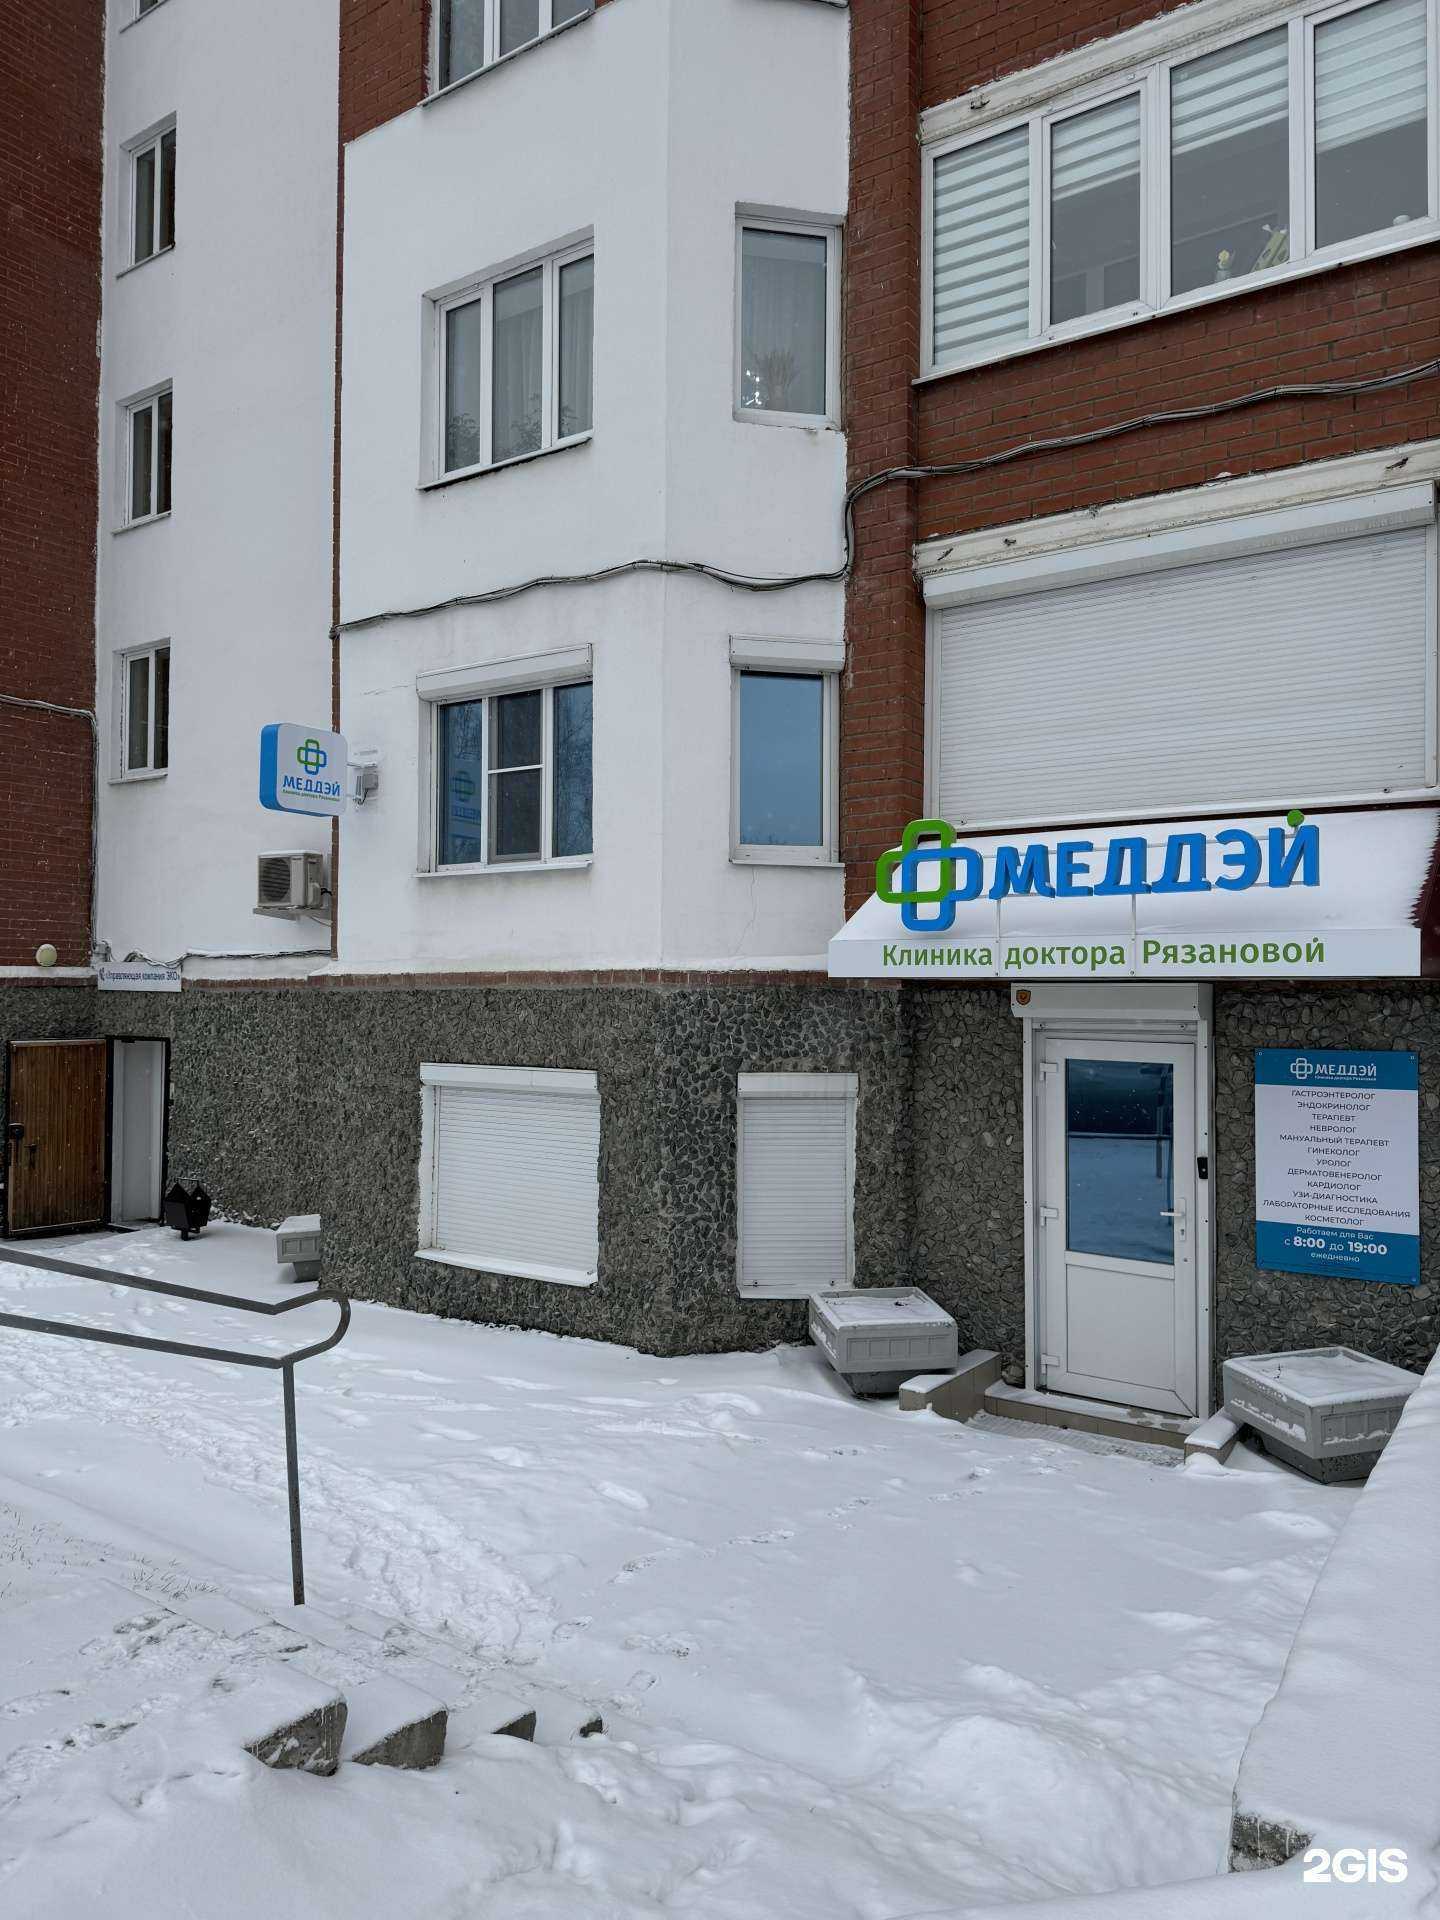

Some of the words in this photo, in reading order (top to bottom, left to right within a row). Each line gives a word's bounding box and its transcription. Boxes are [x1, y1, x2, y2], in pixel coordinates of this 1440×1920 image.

[283, 775, 340, 797] МЕДДЭЙ
[988, 809, 1320, 901] МЕДДЭЙ
[882, 944, 993, 967] Клиника
[1004, 944, 1126, 972] доктора
[1142, 936, 1325, 965] Рязановой
[1315, 1062, 1377, 1078] МЕДДЭЙ
[1291, 1089, 1376, 1100] ГАСТРОЭНТЕРОЛОГ
[1297, 1101, 1371, 1111] ЭНДОКРИНОЛОГ
[1312, 1113, 1357, 1122] ТЕРАПЕВТ
[1310, 1125, 1357, 1134] НЕВРОЛОГ
[1279, 1134, 1343, 1145] МАНУАЛЬНЫЙ
[1345, 1138, 1390, 1147] ТЕРАПЕВТ
[1307, 1147, 1360, 1157] ГИНЕКОЛОГ
[1316, 1159, 1352, 1168] УРОЛОГ
[1287, 1168, 1383, 1182] ДЕРМАТОВЕНЕРОЛОГ
[1307, 1181, 1361, 1191] КАРДИОЛОГ
[1293, 1191, 1378, 1204] УЗИ-ДИАГНОСТИКА
[1263, 1199, 1334, 1212] ЛАБОРАТОРНЫЕ
[1335, 1205, 1411, 1218] ИССЛЕДОВАНИЯ
[1304, 1214, 1364, 1225] КОСМЕТОЛОГ
[1296, 1226, 1338, 1238] Работаем
[1339, 1230, 1356, 1239] для
[1357, 1232, 1374, 1241] Вас
[1284, 1238, 1291, 1246] с
[1293, 1236, 1326, 1249] 8:00
[1329, 1243, 1344, 1252] до
[1347, 1241, 1388, 1256] 19:00
[1310, 1251, 1360, 1263] ежедневно
